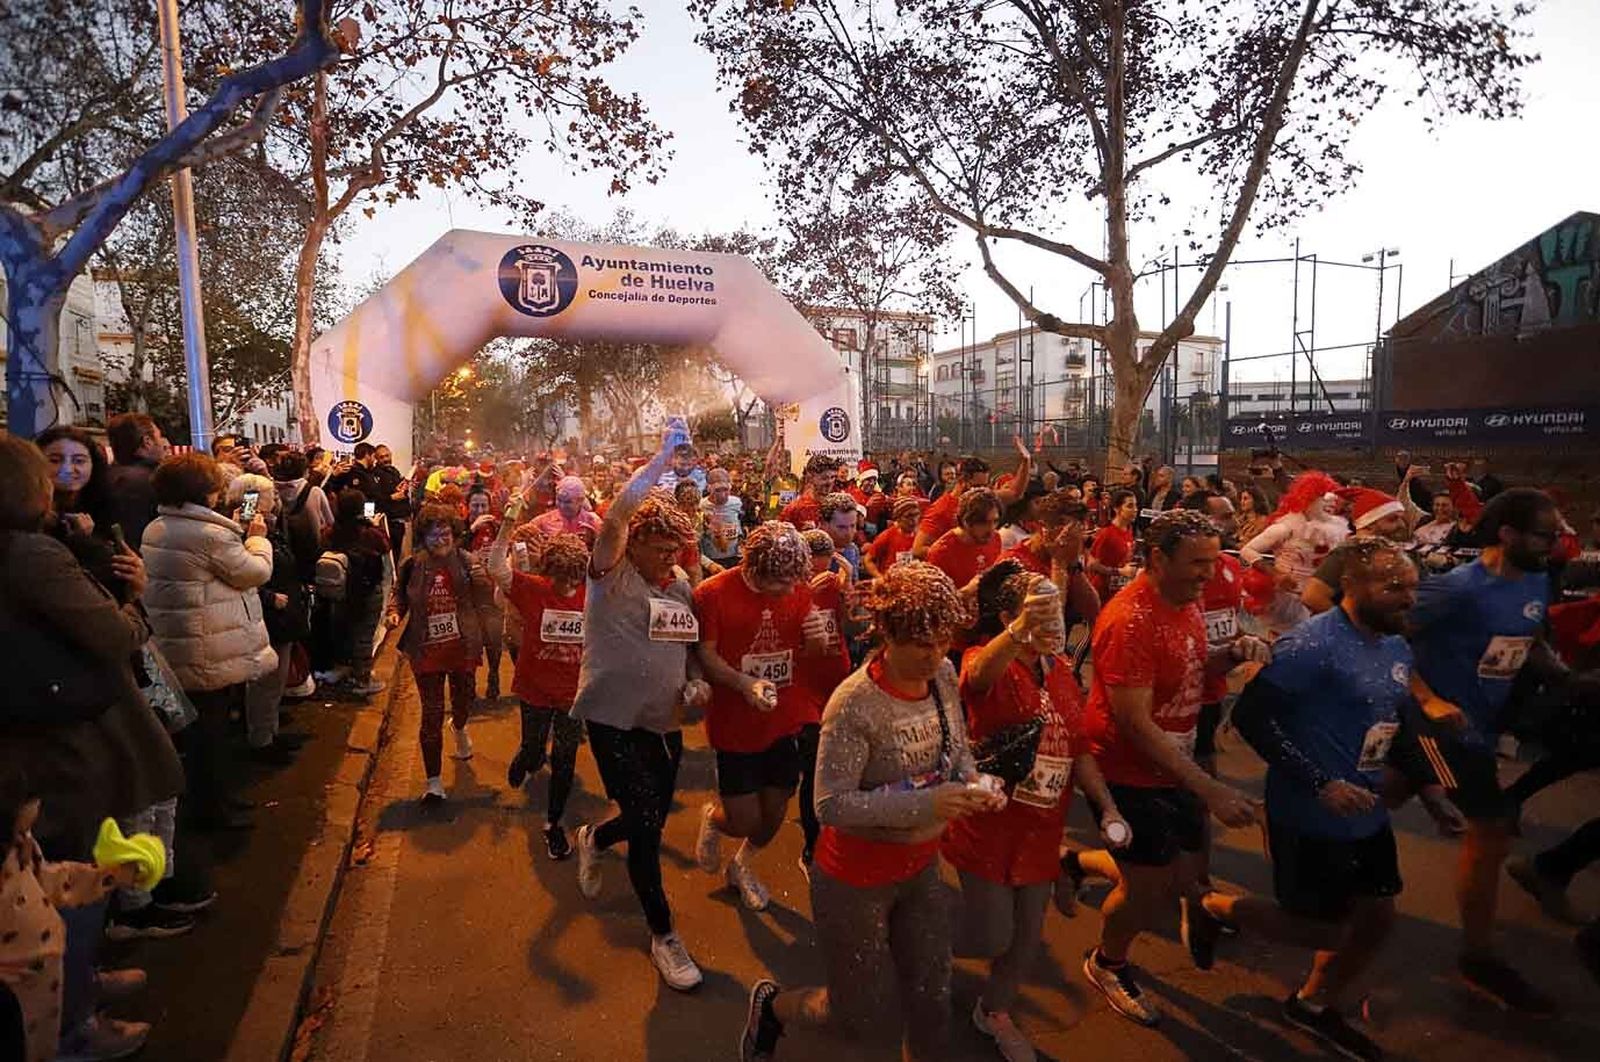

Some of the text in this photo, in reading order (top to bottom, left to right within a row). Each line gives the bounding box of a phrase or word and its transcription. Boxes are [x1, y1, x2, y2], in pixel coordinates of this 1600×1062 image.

[581, 255, 713, 275] Ayuntamiento
[620, 274, 714, 292] de Huelva
[651, 293, 665, 302] de
[668, 294, 716, 305] Deportes
[1411, 417, 1468, 428] HYUNDAI
[1513, 411, 1584, 425] HYUNDAI
[1316, 421, 1361, 431] HYUNDAI
[559, 621, 582, 634] 448
[670, 612, 693, 629] 449
[1214, 619, 1232, 636] 137
[432, 621, 454, 635] 398
[763, 661, 788, 679] 450
